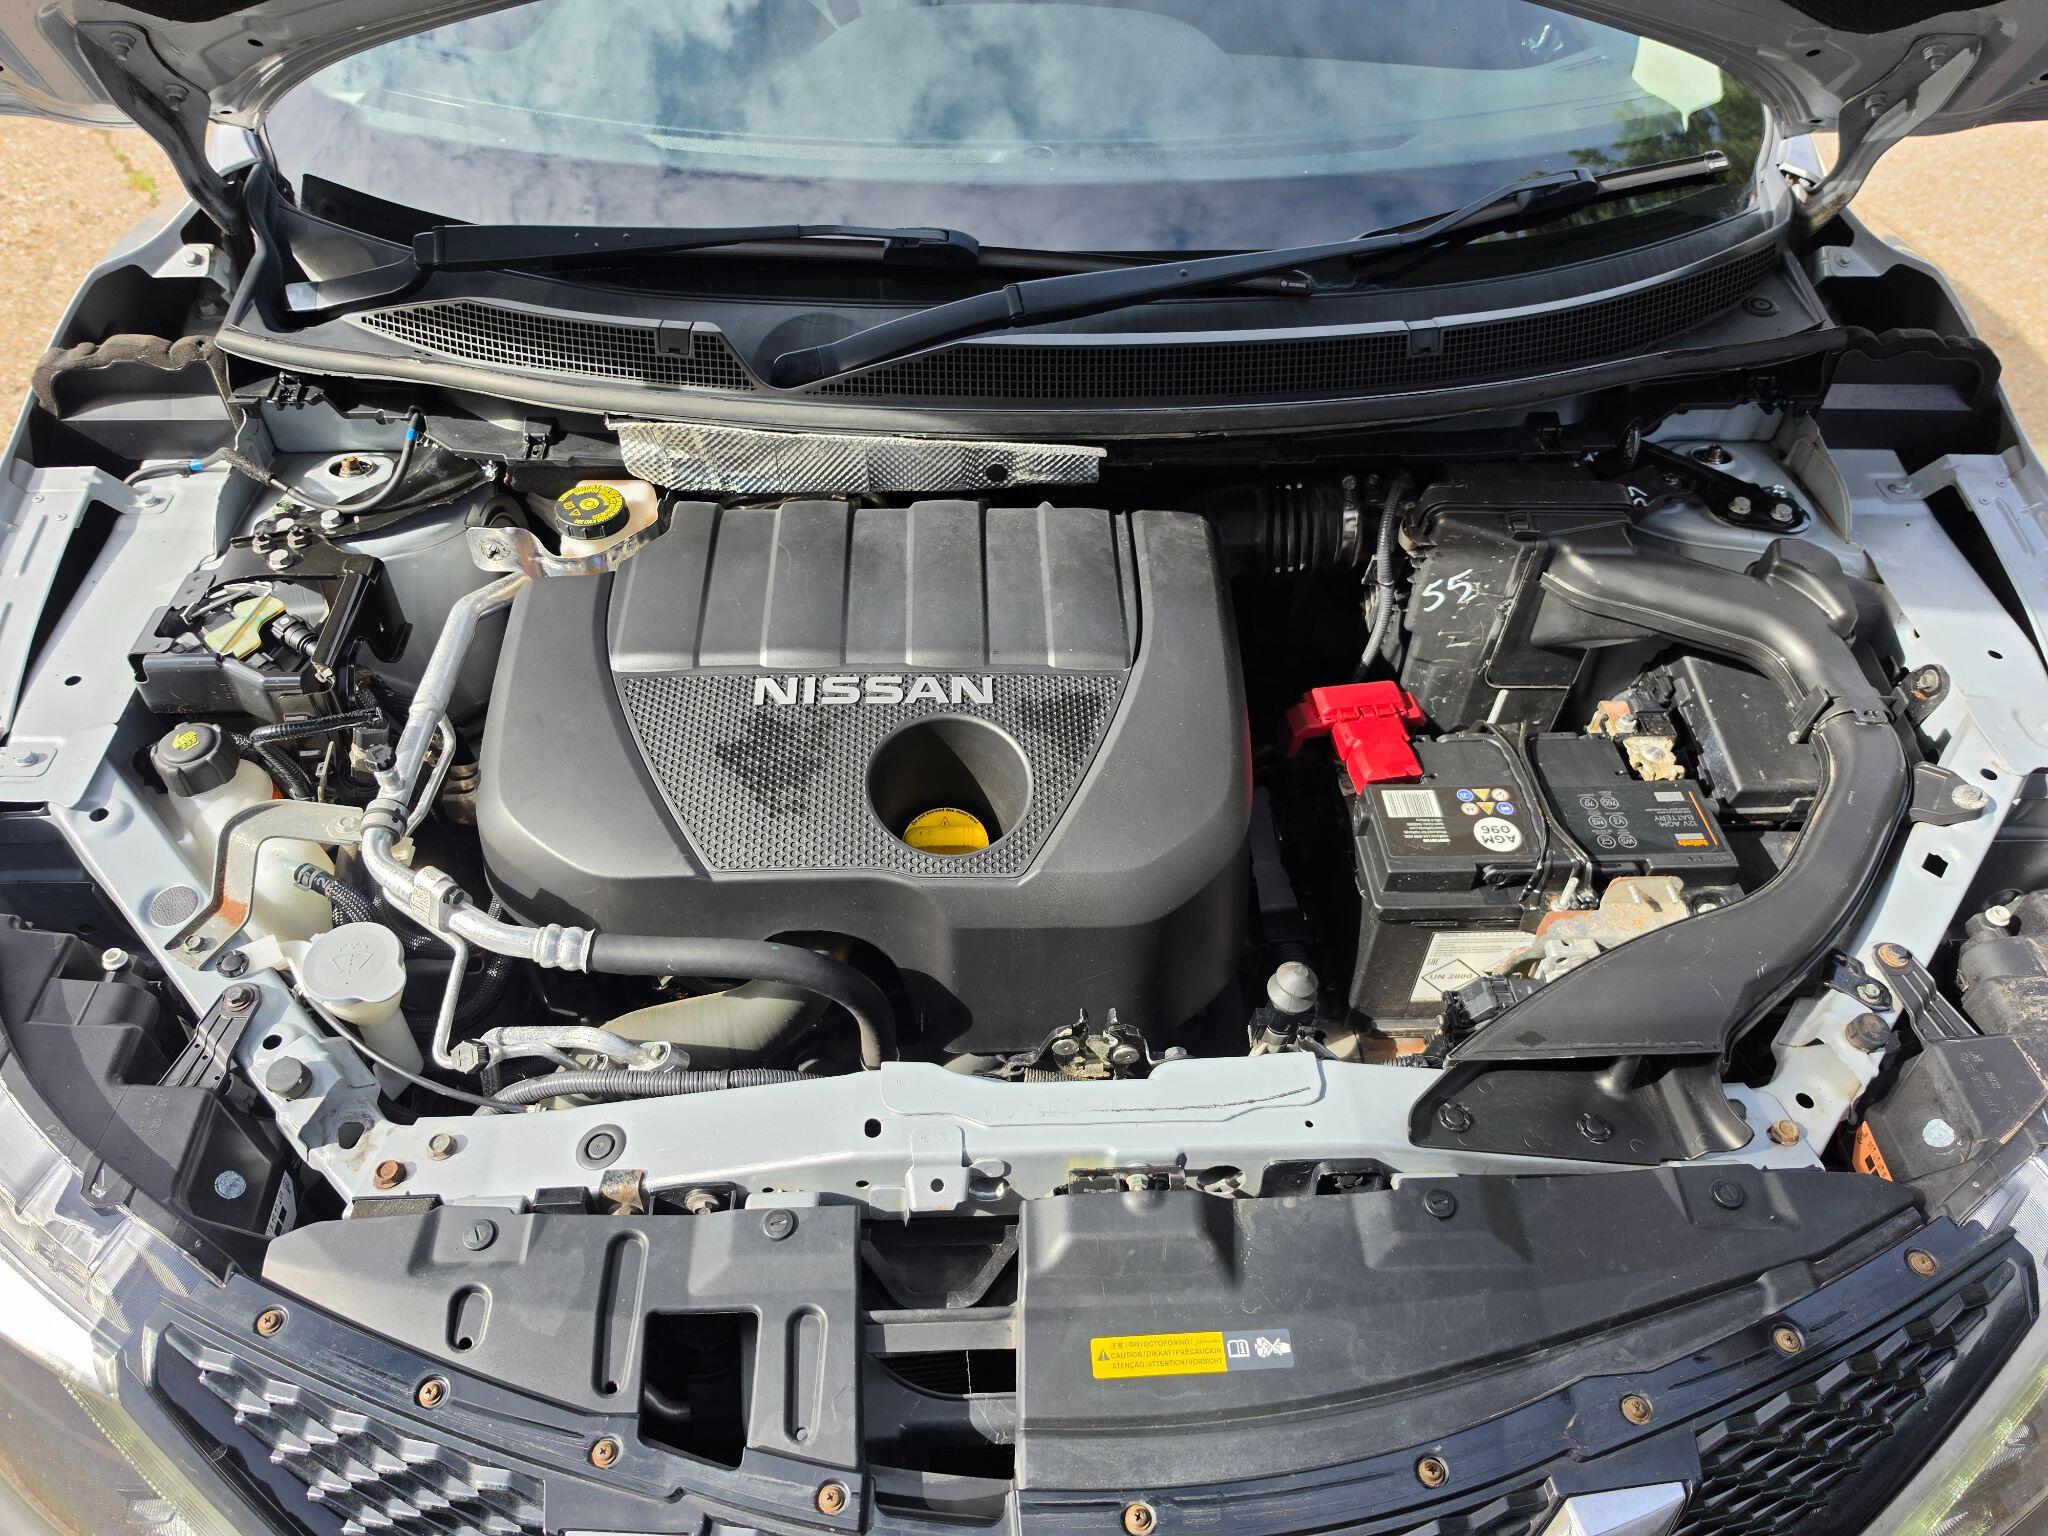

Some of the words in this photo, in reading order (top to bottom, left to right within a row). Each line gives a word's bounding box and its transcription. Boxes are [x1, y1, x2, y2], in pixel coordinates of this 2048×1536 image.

[754, 676, 994, 706] NISSAN
[1481, 825, 1511, 834] 096
[1482, 834, 1516, 844] AGM
[1111, 1351, 1142, 1359] CAUTION
[1148, 1359, 1185, 1367] ATTENTION
